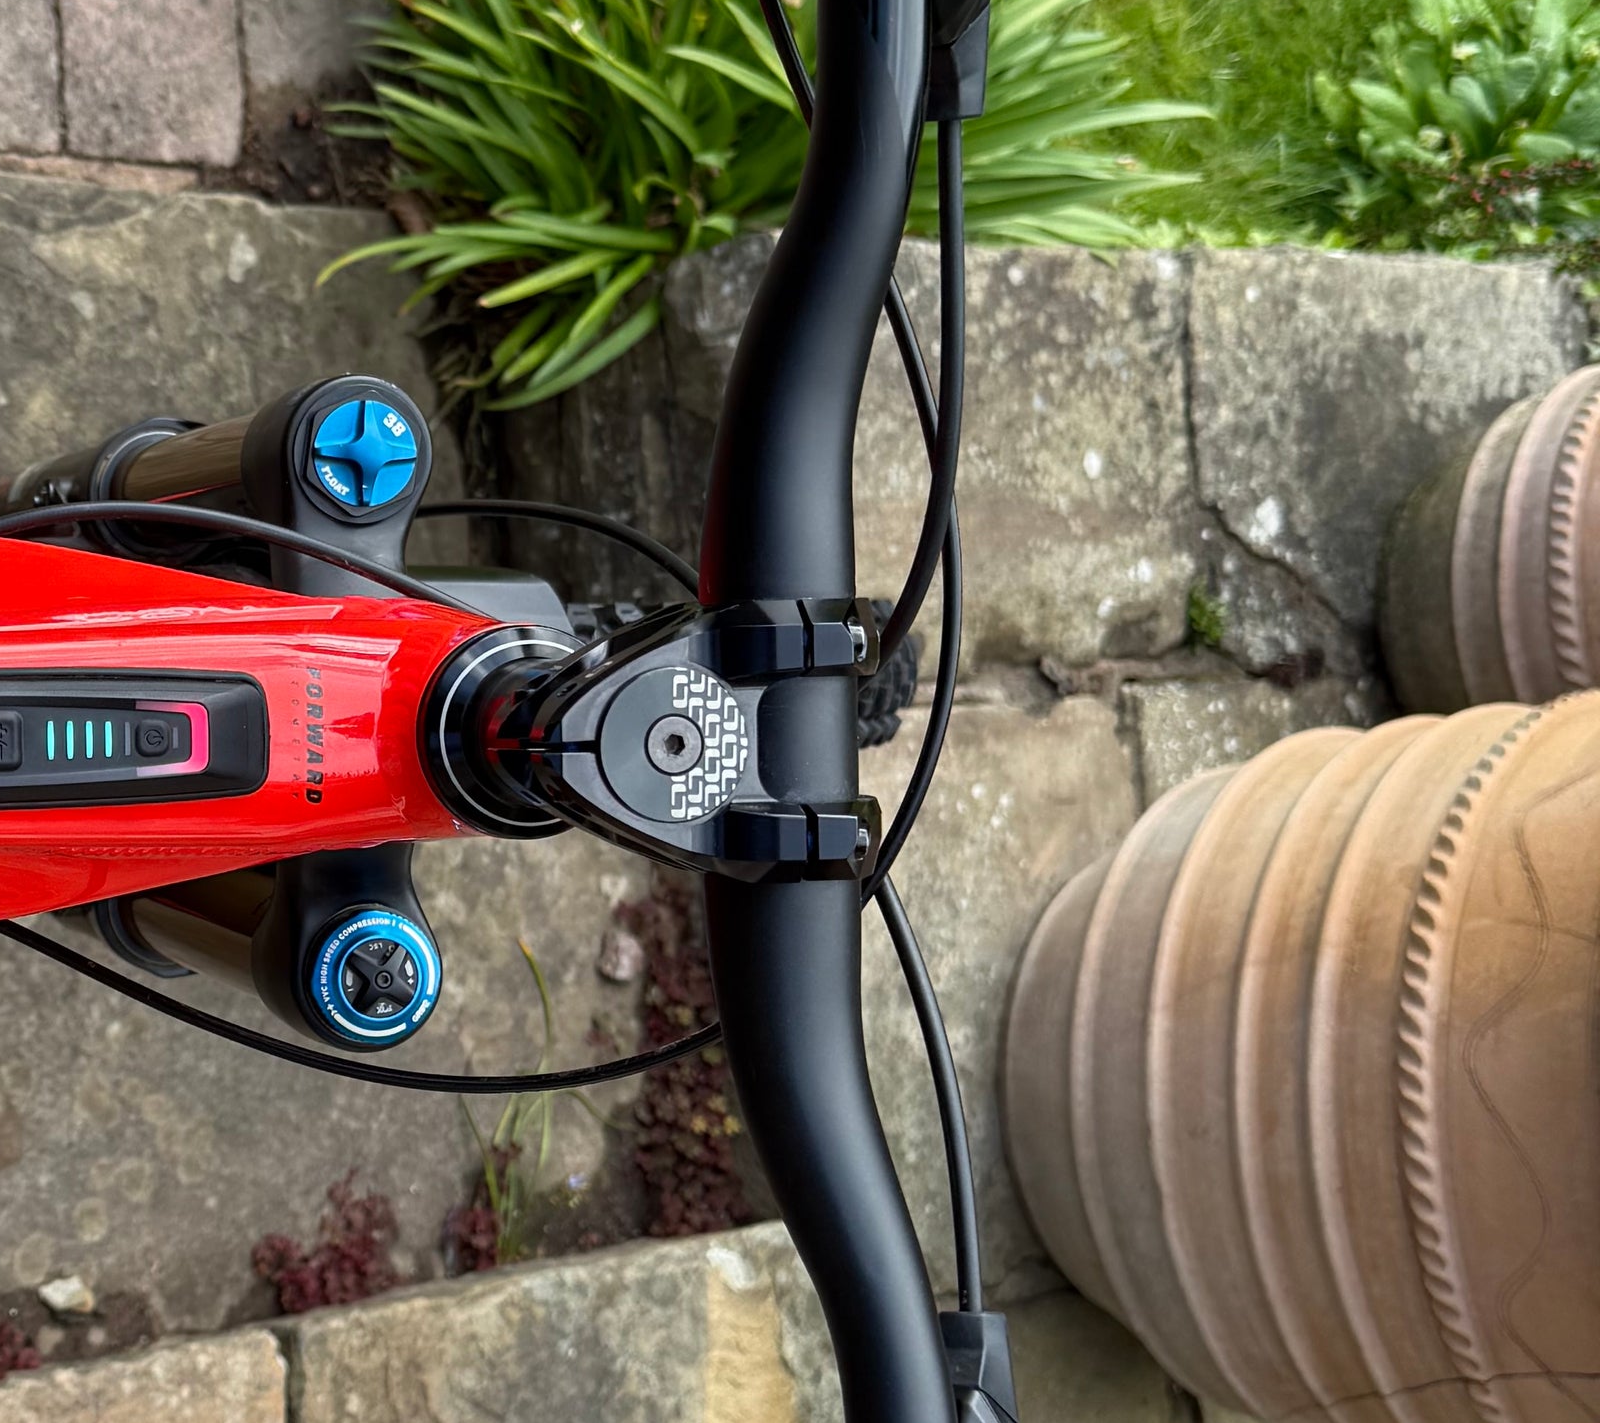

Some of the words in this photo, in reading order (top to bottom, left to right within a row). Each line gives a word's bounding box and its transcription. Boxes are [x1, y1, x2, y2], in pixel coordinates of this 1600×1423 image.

[383, 412, 407, 437] 38
[321, 465, 350, 496] FLOAT
[306, 665, 324, 804] FORWARD
[338, 917, 391, 941] COMPRESSION
[323, 939, 340, 963] SPEED
[320, 965, 328, 985] HIGH
